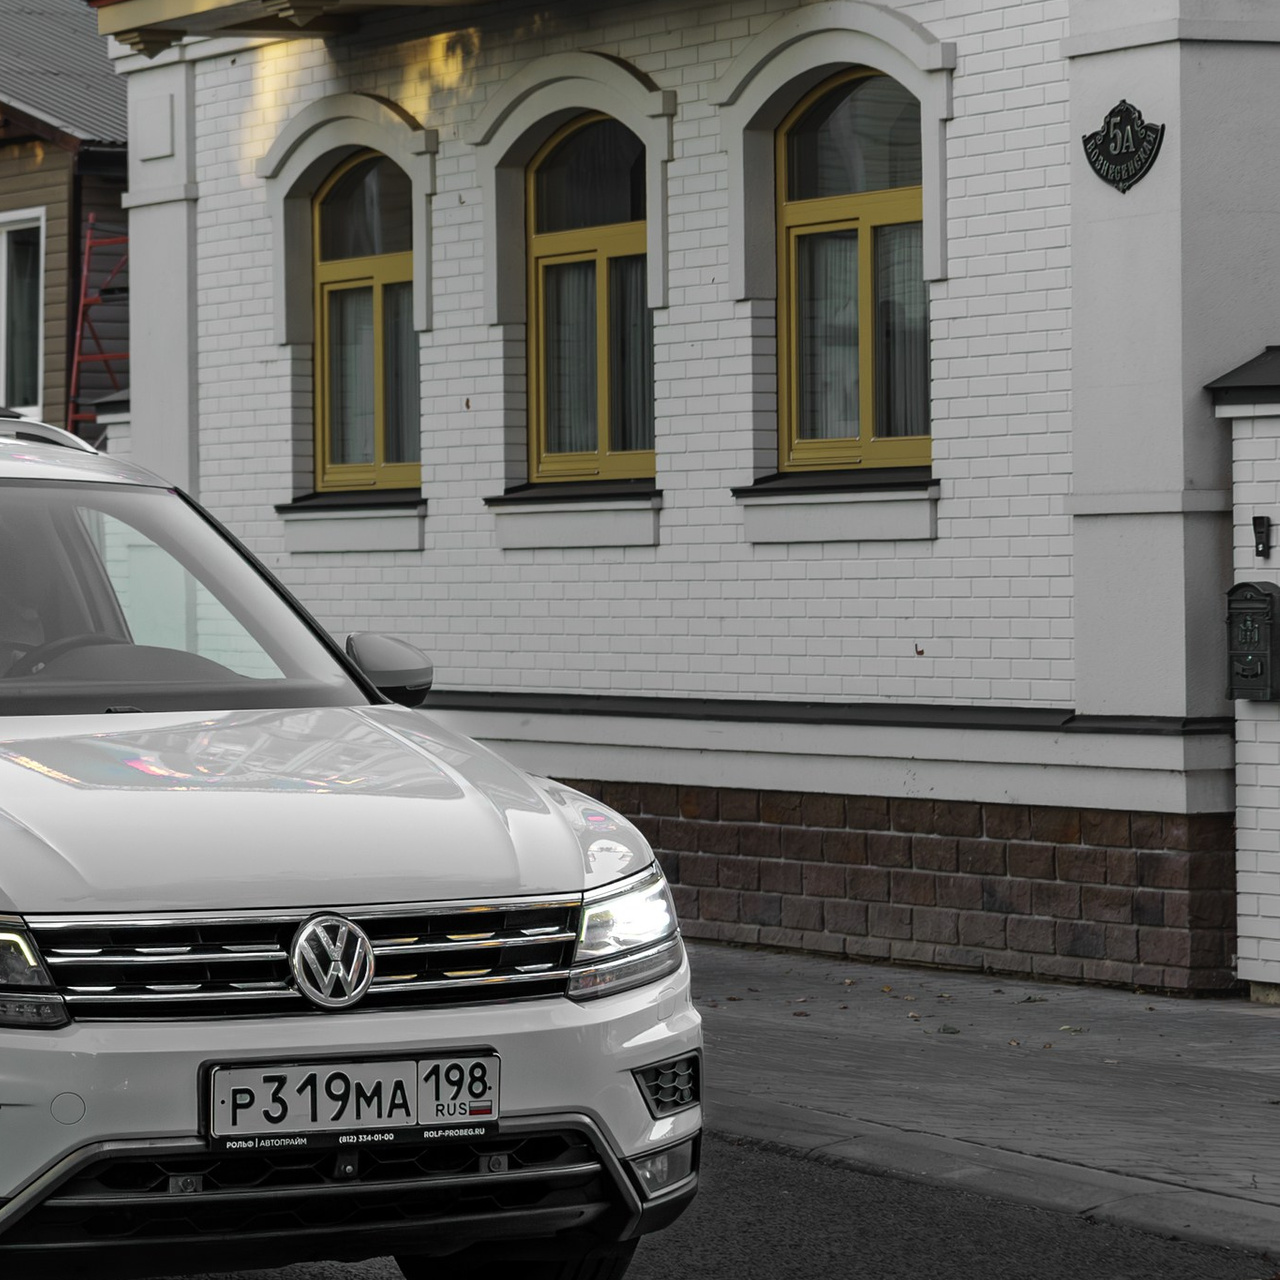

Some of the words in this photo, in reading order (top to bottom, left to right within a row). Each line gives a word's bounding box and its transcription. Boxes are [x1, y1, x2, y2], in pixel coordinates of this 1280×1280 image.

[1109, 116, 1135, 155] 5А
[1086, 131, 1156, 180] ВОЗНЕСЕНСКАЯ
[297, 920, 368, 1002] VW
[423, 1061, 488, 1102] 198
[435, 1103, 468, 1117] RUS
[226, 1140, 254, 1149] РОЛЬФ
[260, 1137, 307, 1147] АВТОПРАЙМ
[338, 1135, 357, 1144] (812)
[358, 1133, 395, 1142] 334-01-00
[423, 1128, 485, 1138] ROLF-PROBEG.RU
